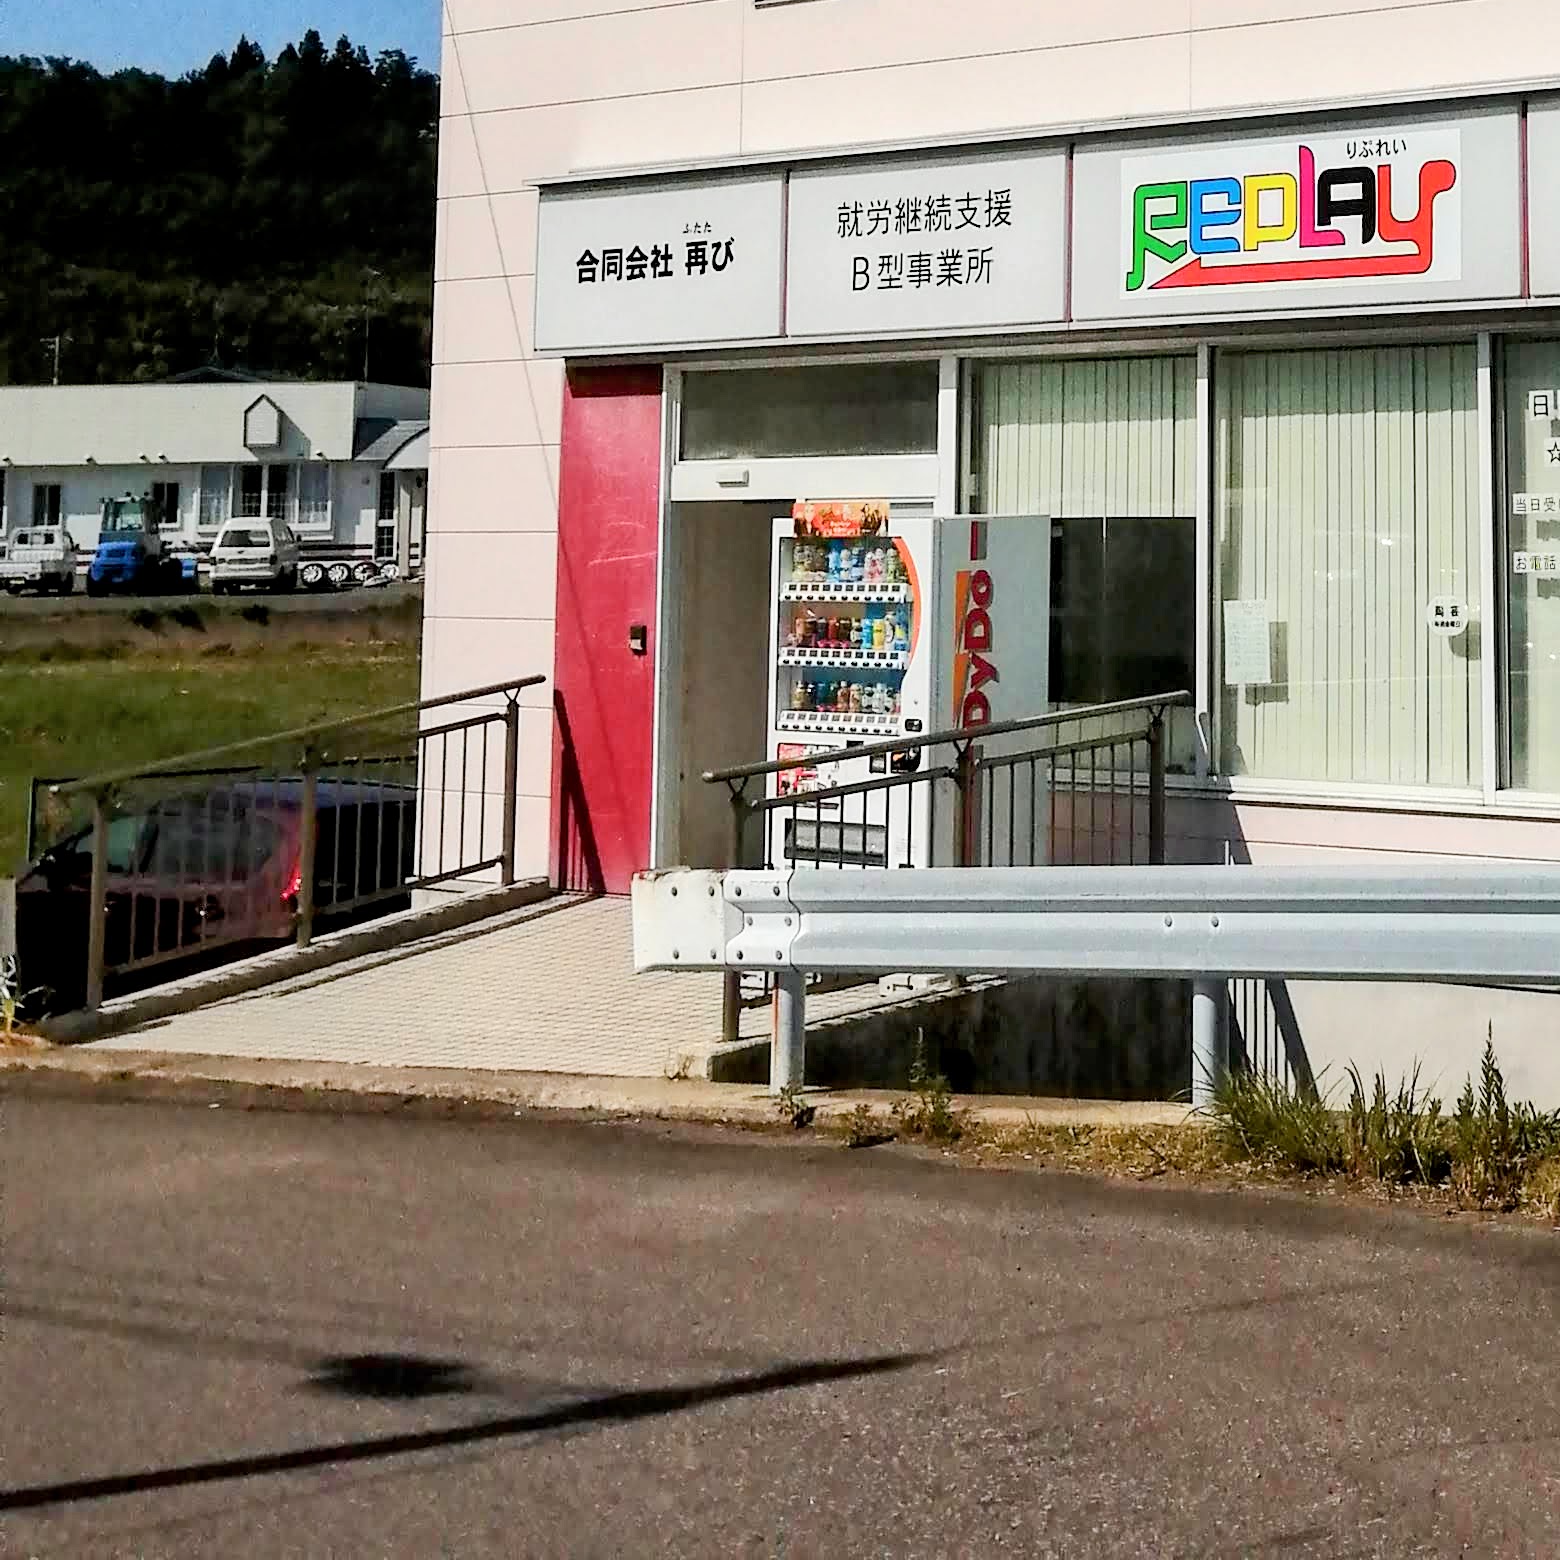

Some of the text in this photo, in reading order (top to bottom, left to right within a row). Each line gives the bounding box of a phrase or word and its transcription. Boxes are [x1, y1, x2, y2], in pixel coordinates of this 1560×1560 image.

[1346, 138, 1407, 160] りぷれい
[682, 221, 712, 234] ふたた
[837, 188, 1013, 238] 就労継続支援
[576, 237, 735, 284] 合同会社 再び
[852, 246, 995, 291] B型事業所
